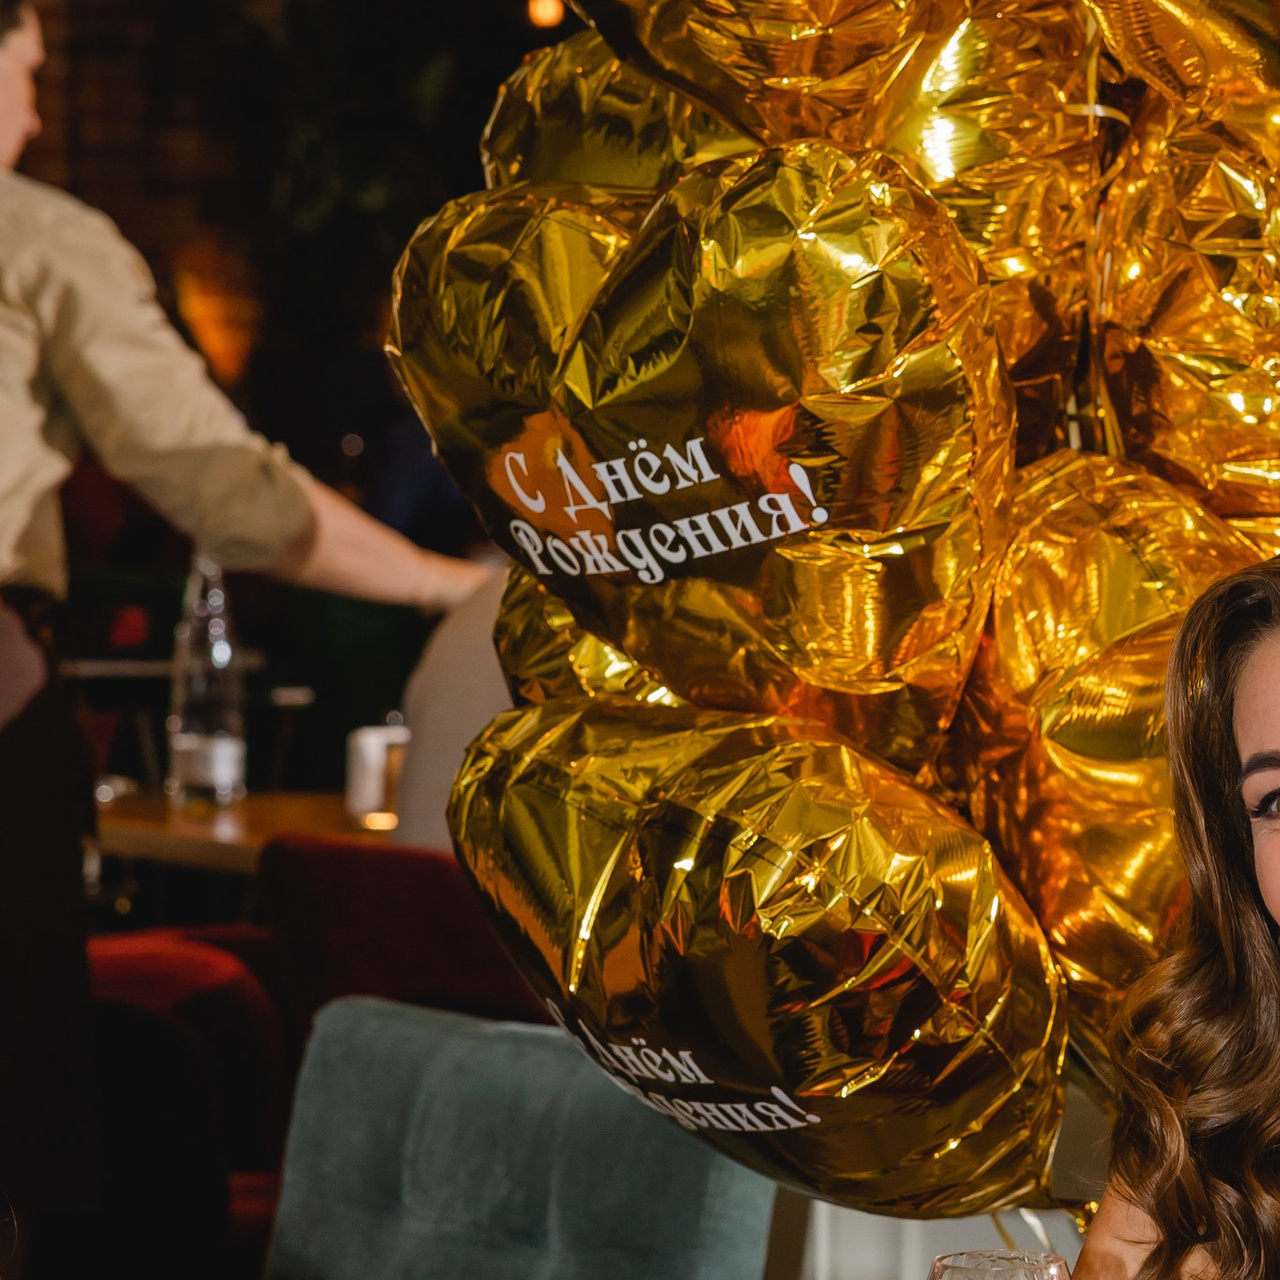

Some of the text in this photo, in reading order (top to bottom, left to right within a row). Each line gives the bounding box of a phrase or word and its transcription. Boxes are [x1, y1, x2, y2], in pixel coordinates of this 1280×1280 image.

[504, 436, 721, 525] С Днём
[509, 463, 829, 585] Рождения!
